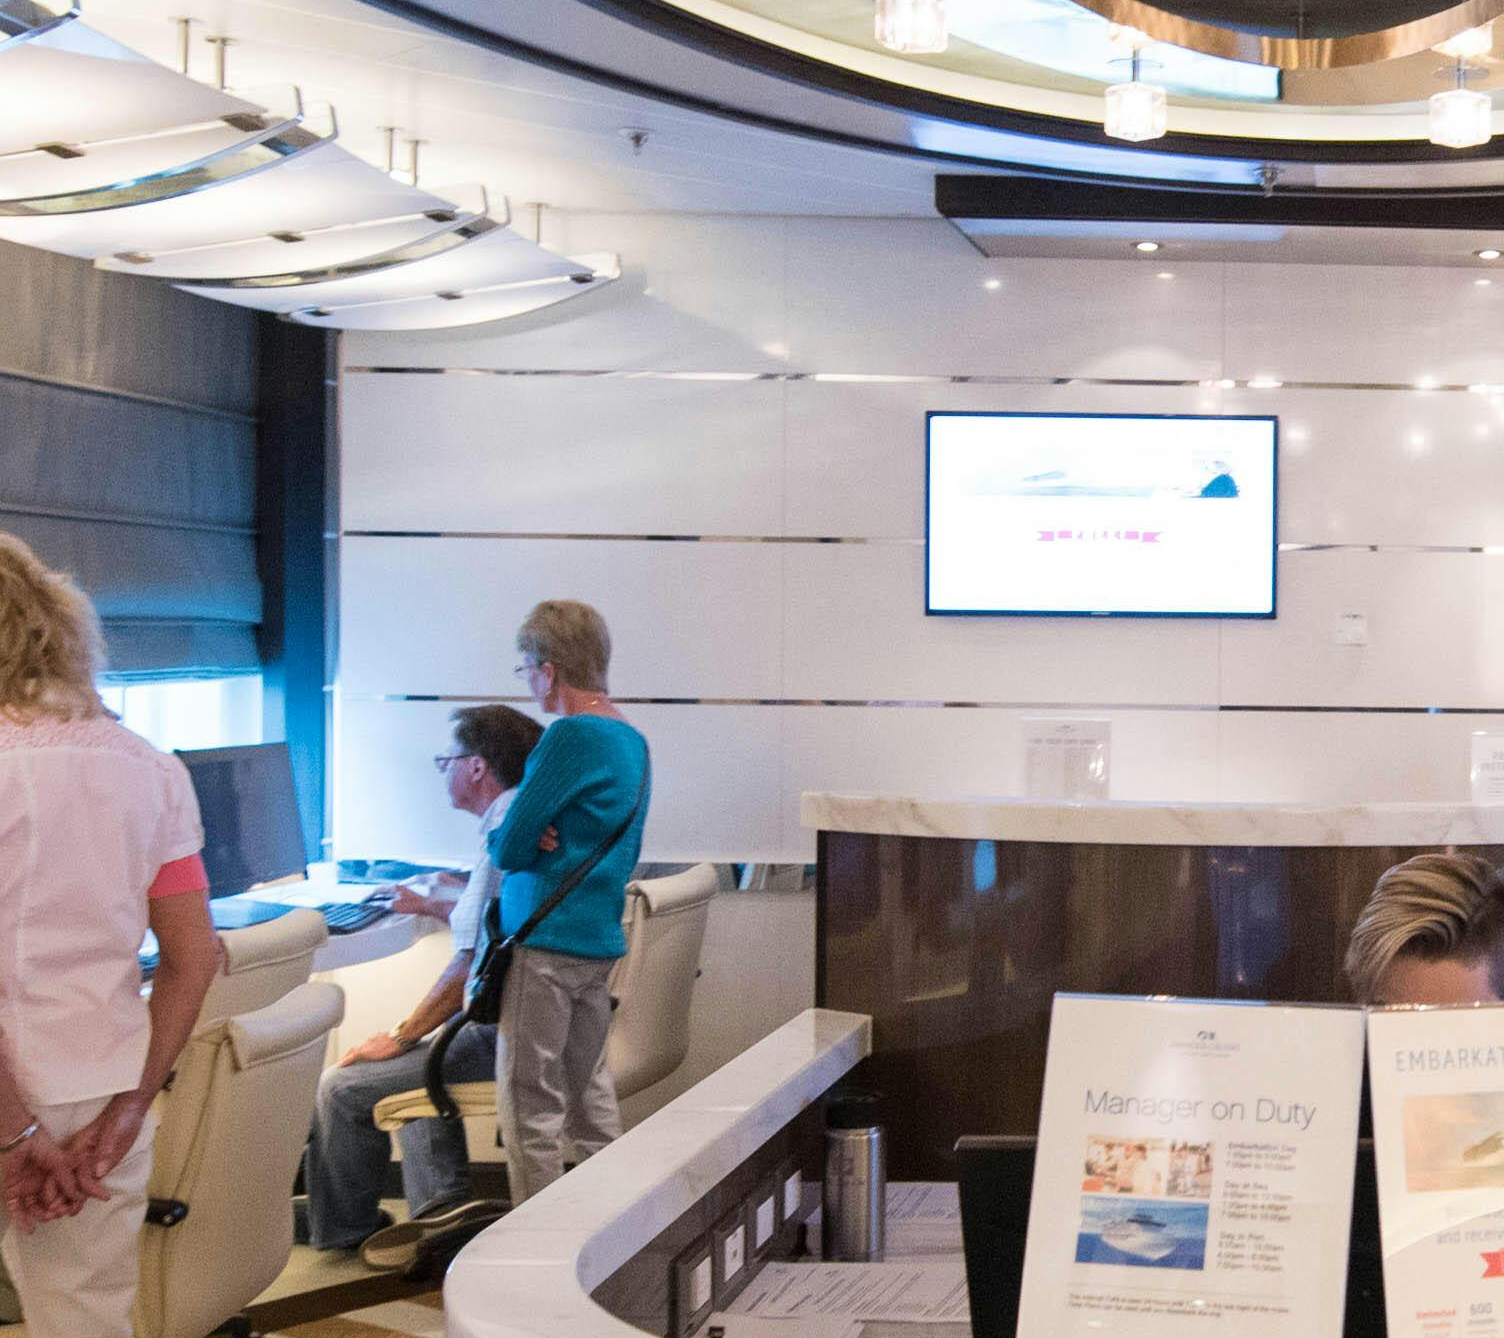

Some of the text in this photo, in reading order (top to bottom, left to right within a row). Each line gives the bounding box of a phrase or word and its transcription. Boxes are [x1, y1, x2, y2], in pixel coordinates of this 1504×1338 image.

[1084, 1090, 1317, 1131] Manager on Duty
